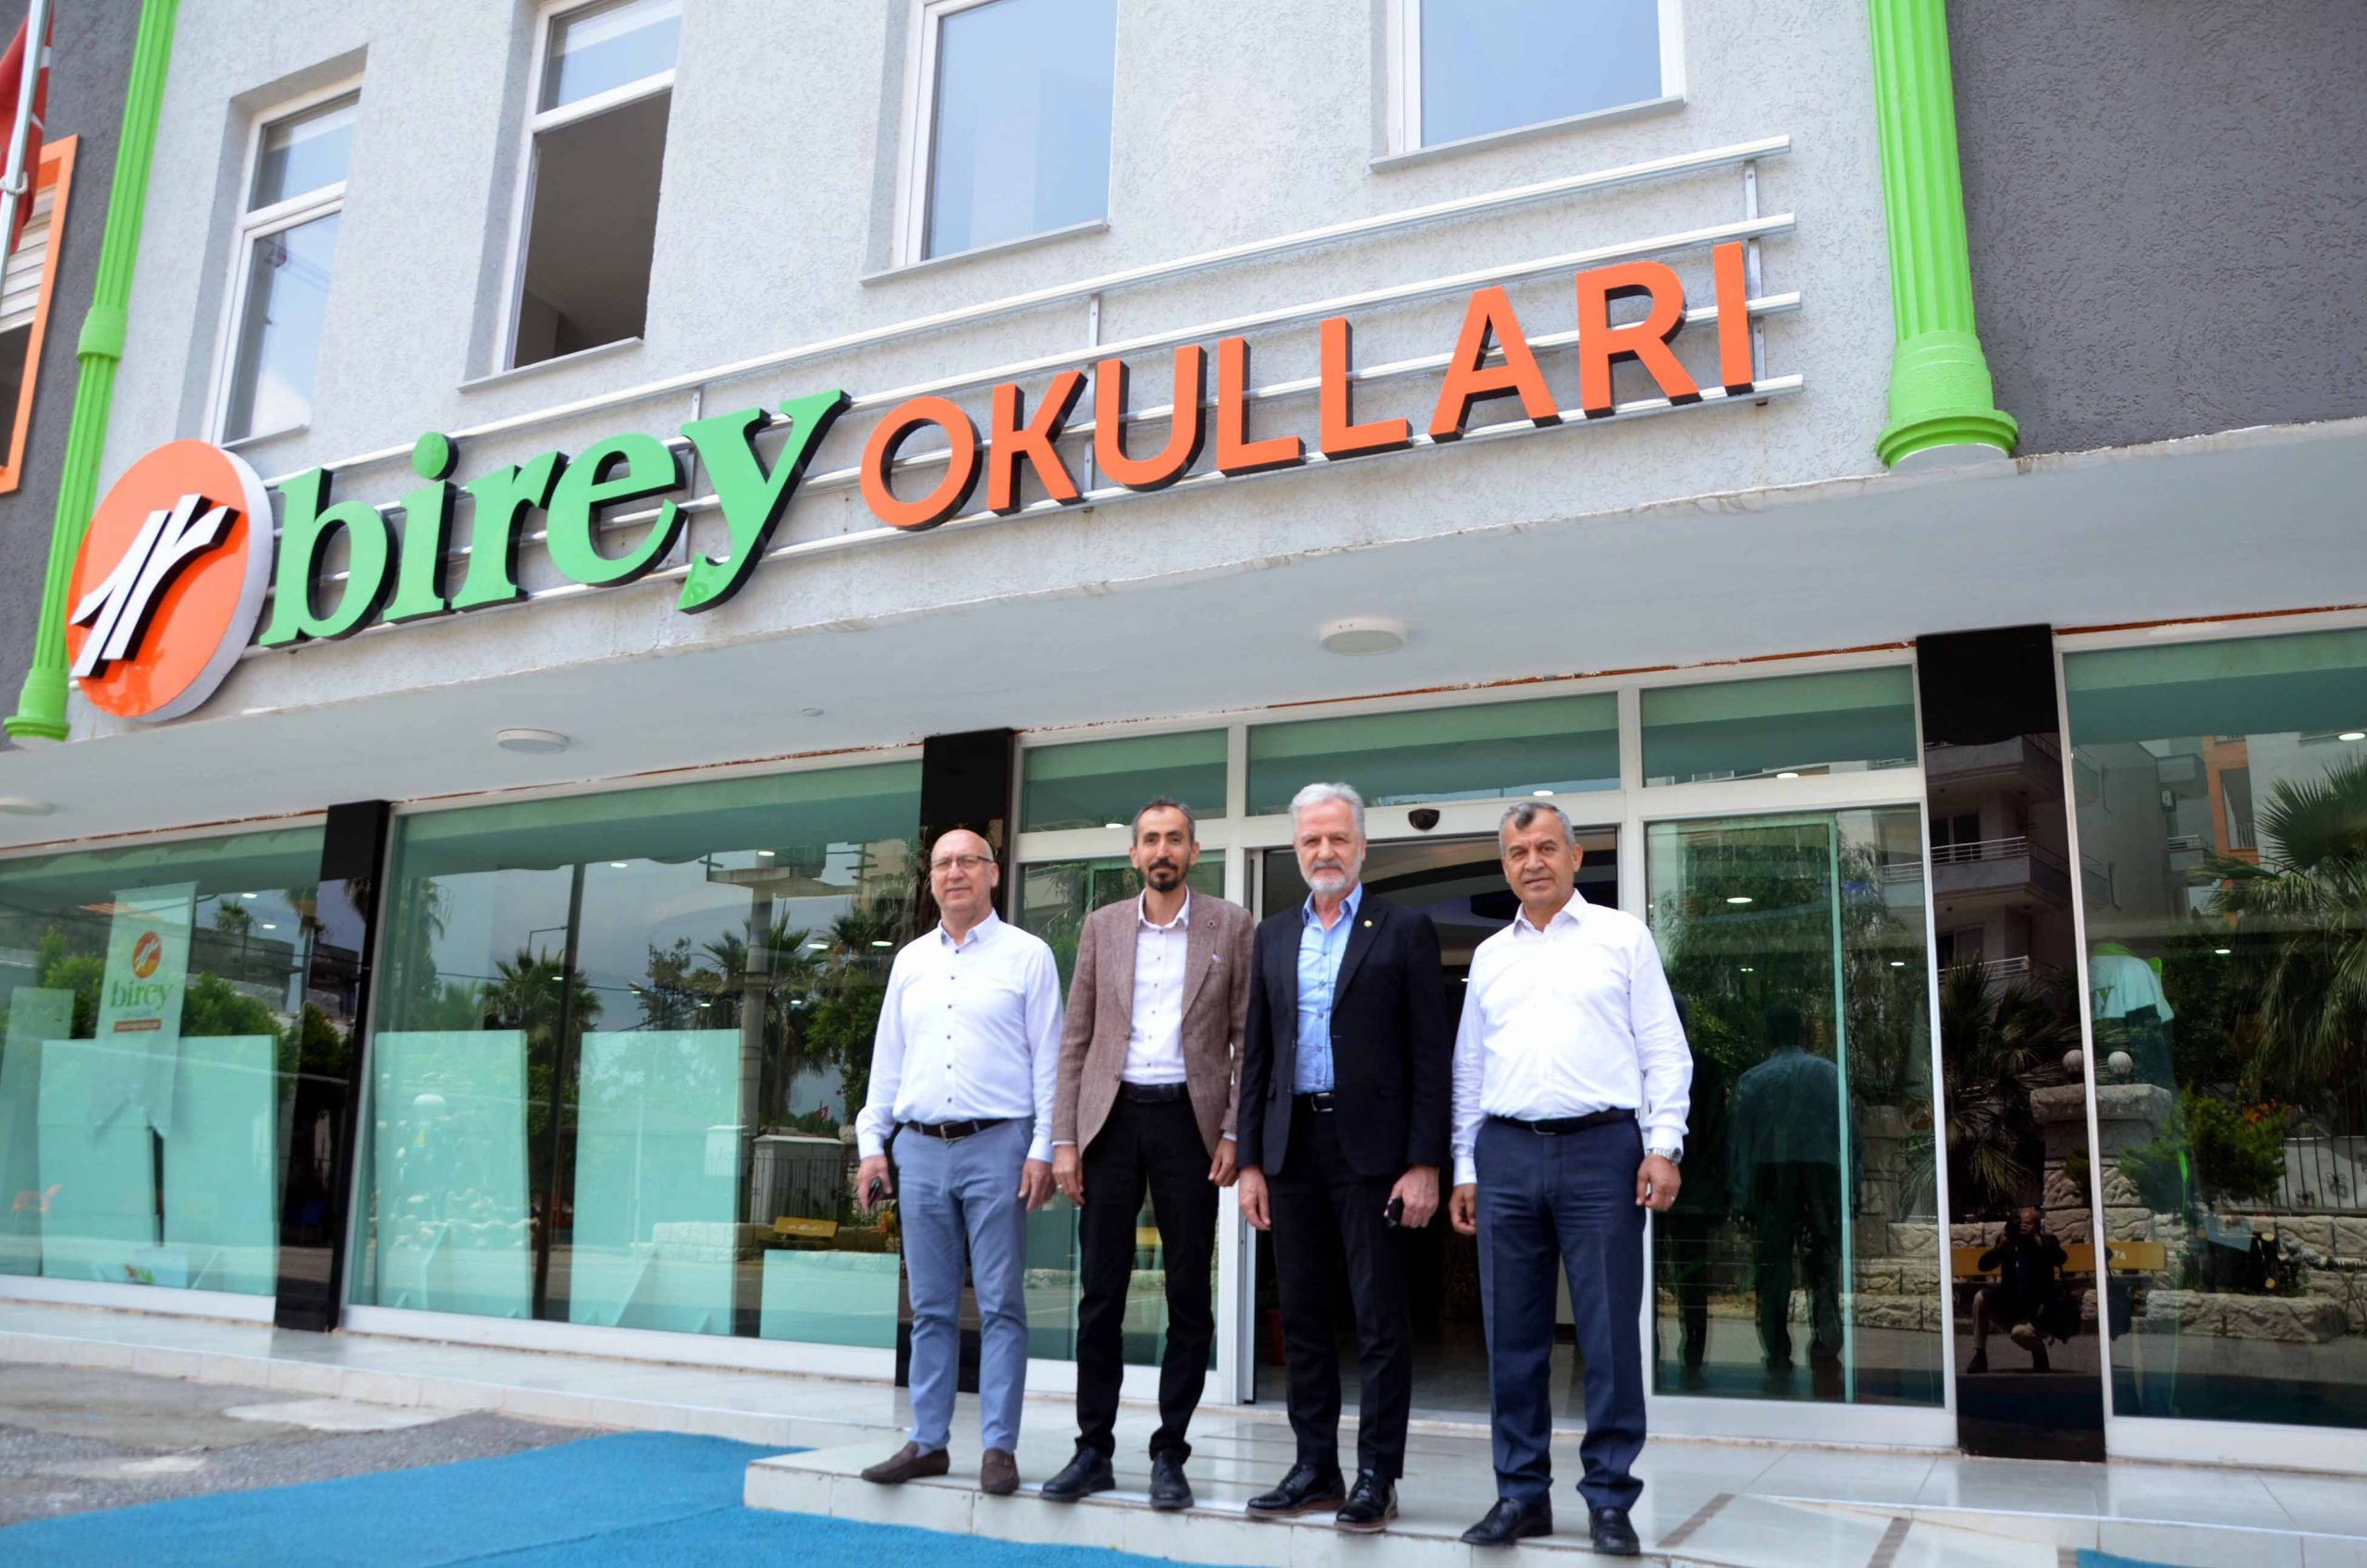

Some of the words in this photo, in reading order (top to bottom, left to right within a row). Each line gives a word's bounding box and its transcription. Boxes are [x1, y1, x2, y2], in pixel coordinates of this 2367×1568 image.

[259, 389, 849, 648] birey
[860, 242, 1753, 530] OKULLARI
[110, 980, 174, 1011] birey
